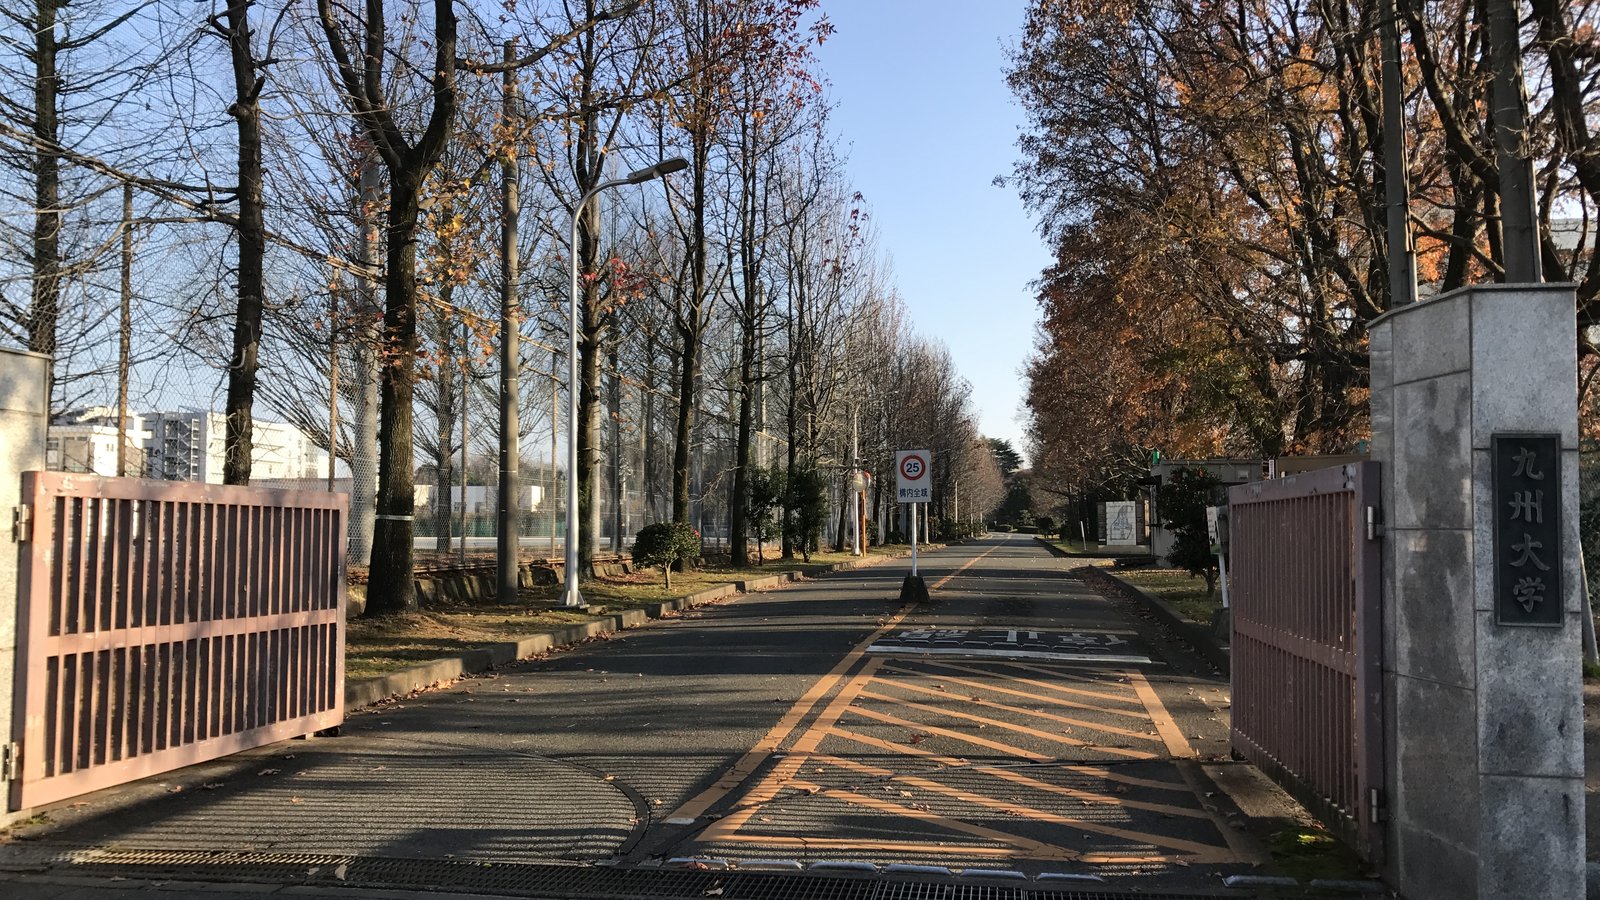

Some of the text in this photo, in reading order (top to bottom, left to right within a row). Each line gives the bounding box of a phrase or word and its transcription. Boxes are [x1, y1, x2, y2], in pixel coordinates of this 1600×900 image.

[906, 463, 920, 473] 25
[899, 488, 928, 498] 構内全域
[1508, 447, 1550, 613] 九州大学
